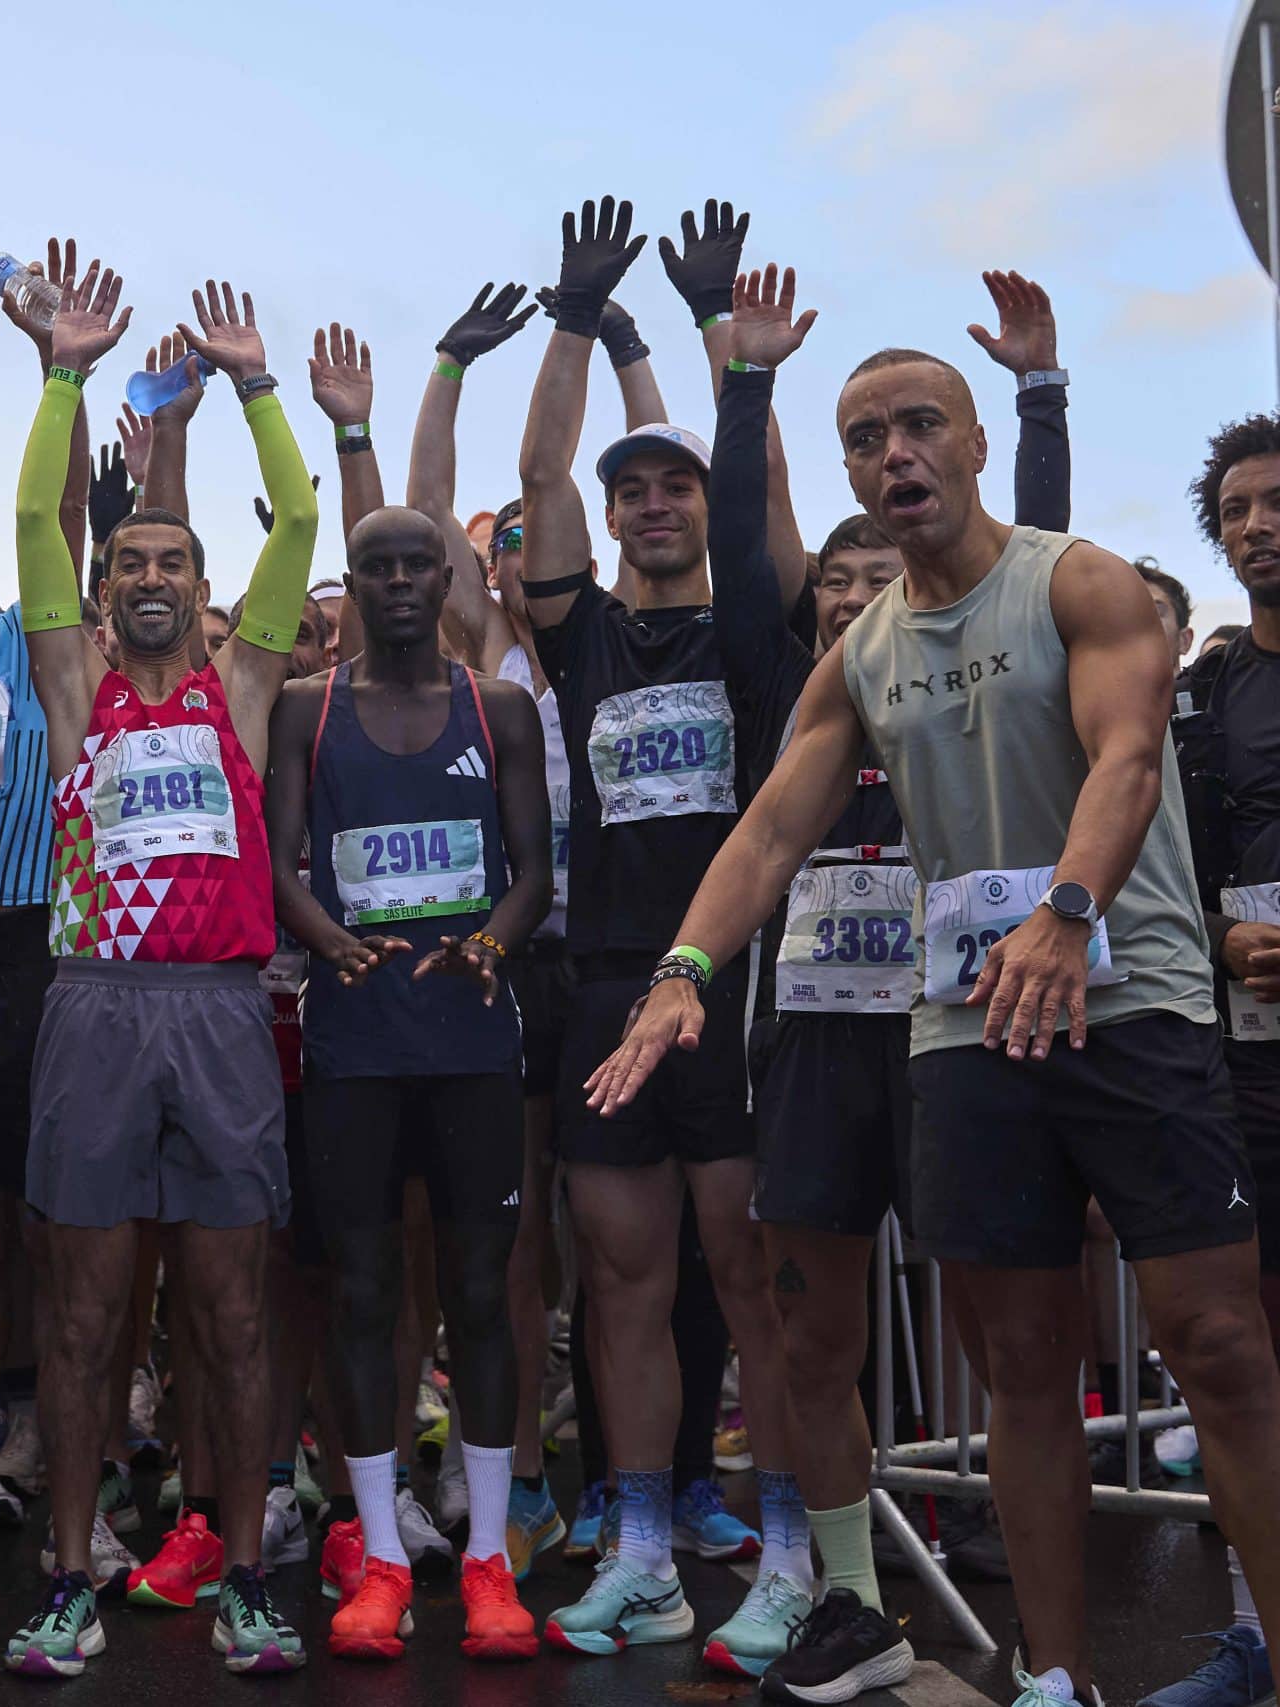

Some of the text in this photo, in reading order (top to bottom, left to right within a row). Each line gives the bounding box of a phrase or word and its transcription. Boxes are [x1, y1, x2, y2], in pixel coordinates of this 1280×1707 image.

[887, 652, 1012, 706] HYROX
[614, 727, 706, 778] 2520
[118, 770, 205, 819] 2481
[363, 828, 451, 876] 2914
[384, 905, 424, 920] SAS ELITE
[812, 916, 914, 962] 3382
[658, 968, 700, 986] HYRO
